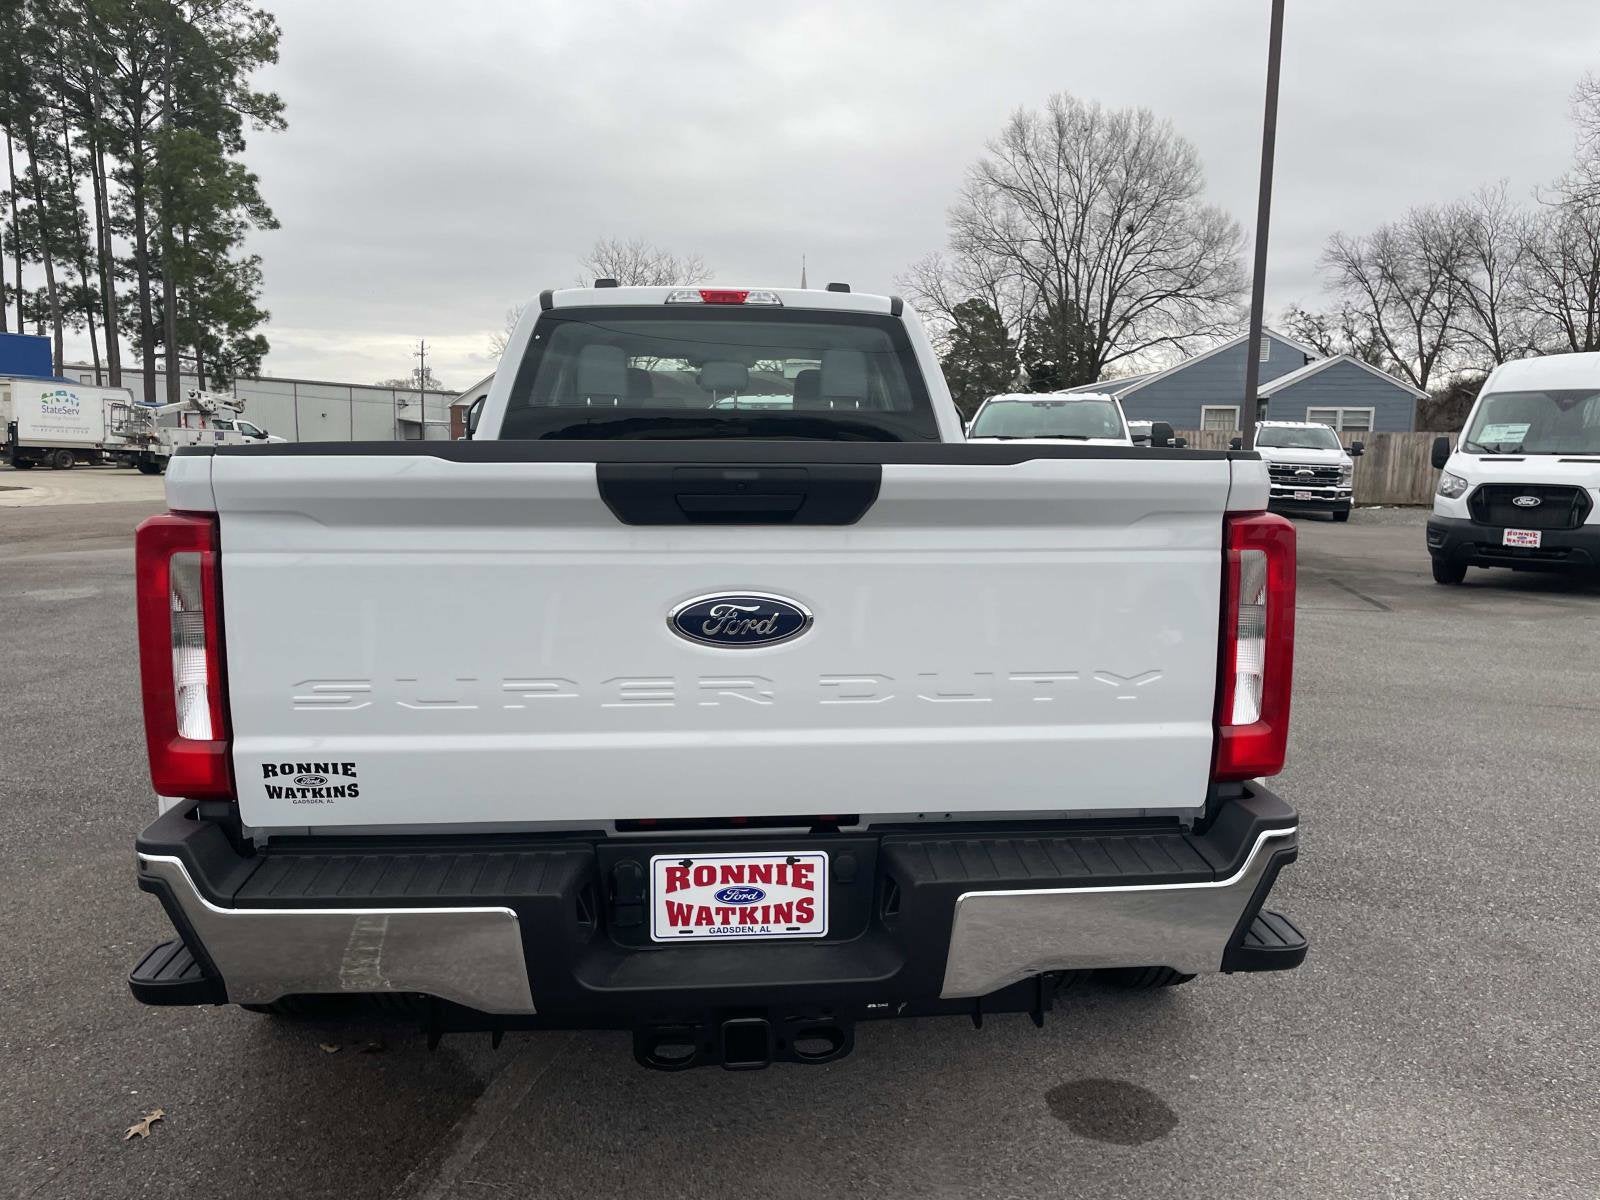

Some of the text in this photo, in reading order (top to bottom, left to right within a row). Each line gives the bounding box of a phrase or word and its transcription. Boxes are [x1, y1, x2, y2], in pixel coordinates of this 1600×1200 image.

[41, 404, 80, 415] StateServ
[1506, 531, 1538, 539] RONNIE
[702, 603, 780, 636] Ford
[292, 669, 1163, 711] SUPER DUTY
[261, 762, 357, 779] RONNIE
[264, 783, 360, 800] WATKINS
[665, 863, 815, 894] RONNIE
[722, 888, 758, 901] Ford
[665, 896, 815, 927] WATKINS
[708, 926, 772, 935] GADSDEN, AL
